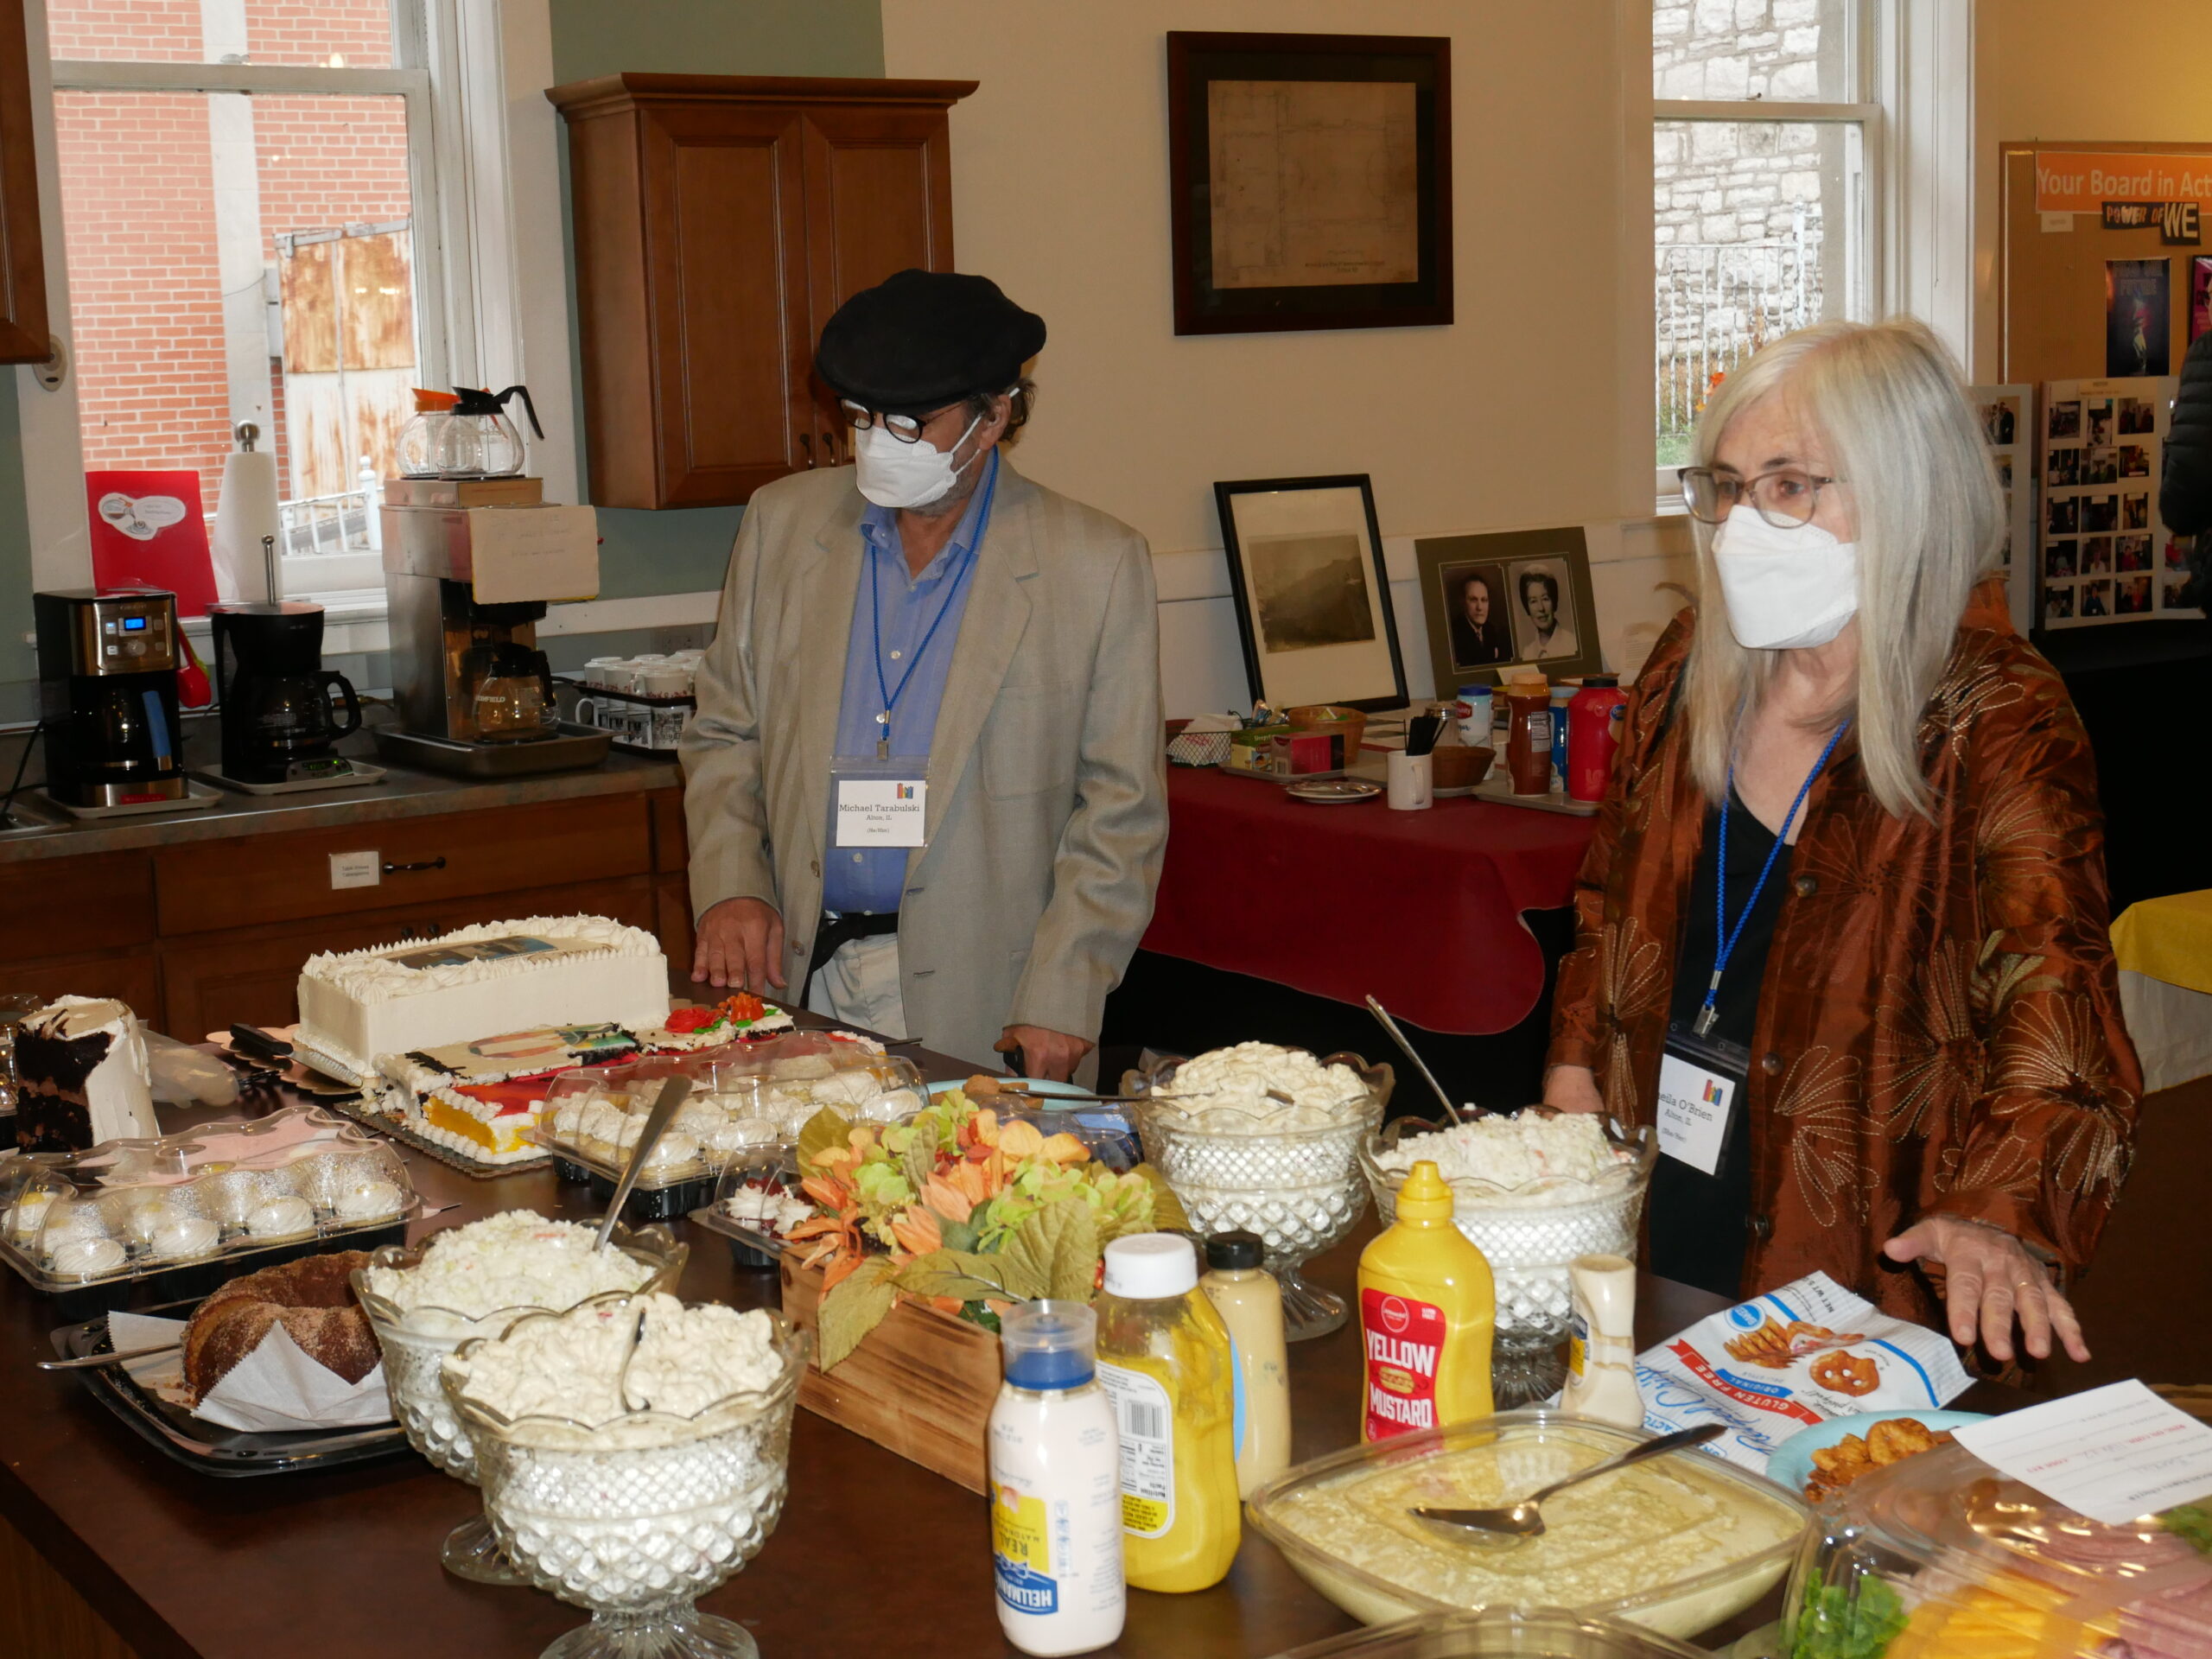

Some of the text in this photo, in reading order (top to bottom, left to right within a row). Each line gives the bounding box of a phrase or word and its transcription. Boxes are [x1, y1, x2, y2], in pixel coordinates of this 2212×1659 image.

[2037, 168, 2083, 194] Your
[2091, 169, 2152, 196] Board
[2158, 170, 2174, 196] in
[2107, 206, 2147, 226] POWER
[2164, 202, 2198, 238] WE
[839, 804, 873, 812] Michael
[1658, 1092, 1713, 1122] eila O'Brien
[1811, 1285, 1825, 1297] WT
[1821, 1298, 1834, 1313] NET
[1366, 1329, 1435, 1377] YELLOW
[1695, 1364, 1789, 1410] GLUTEN FREE
[1729, 1376, 1780, 1394] ORIGINAL
[1370, 1382, 1433, 1427] MUSTARD
